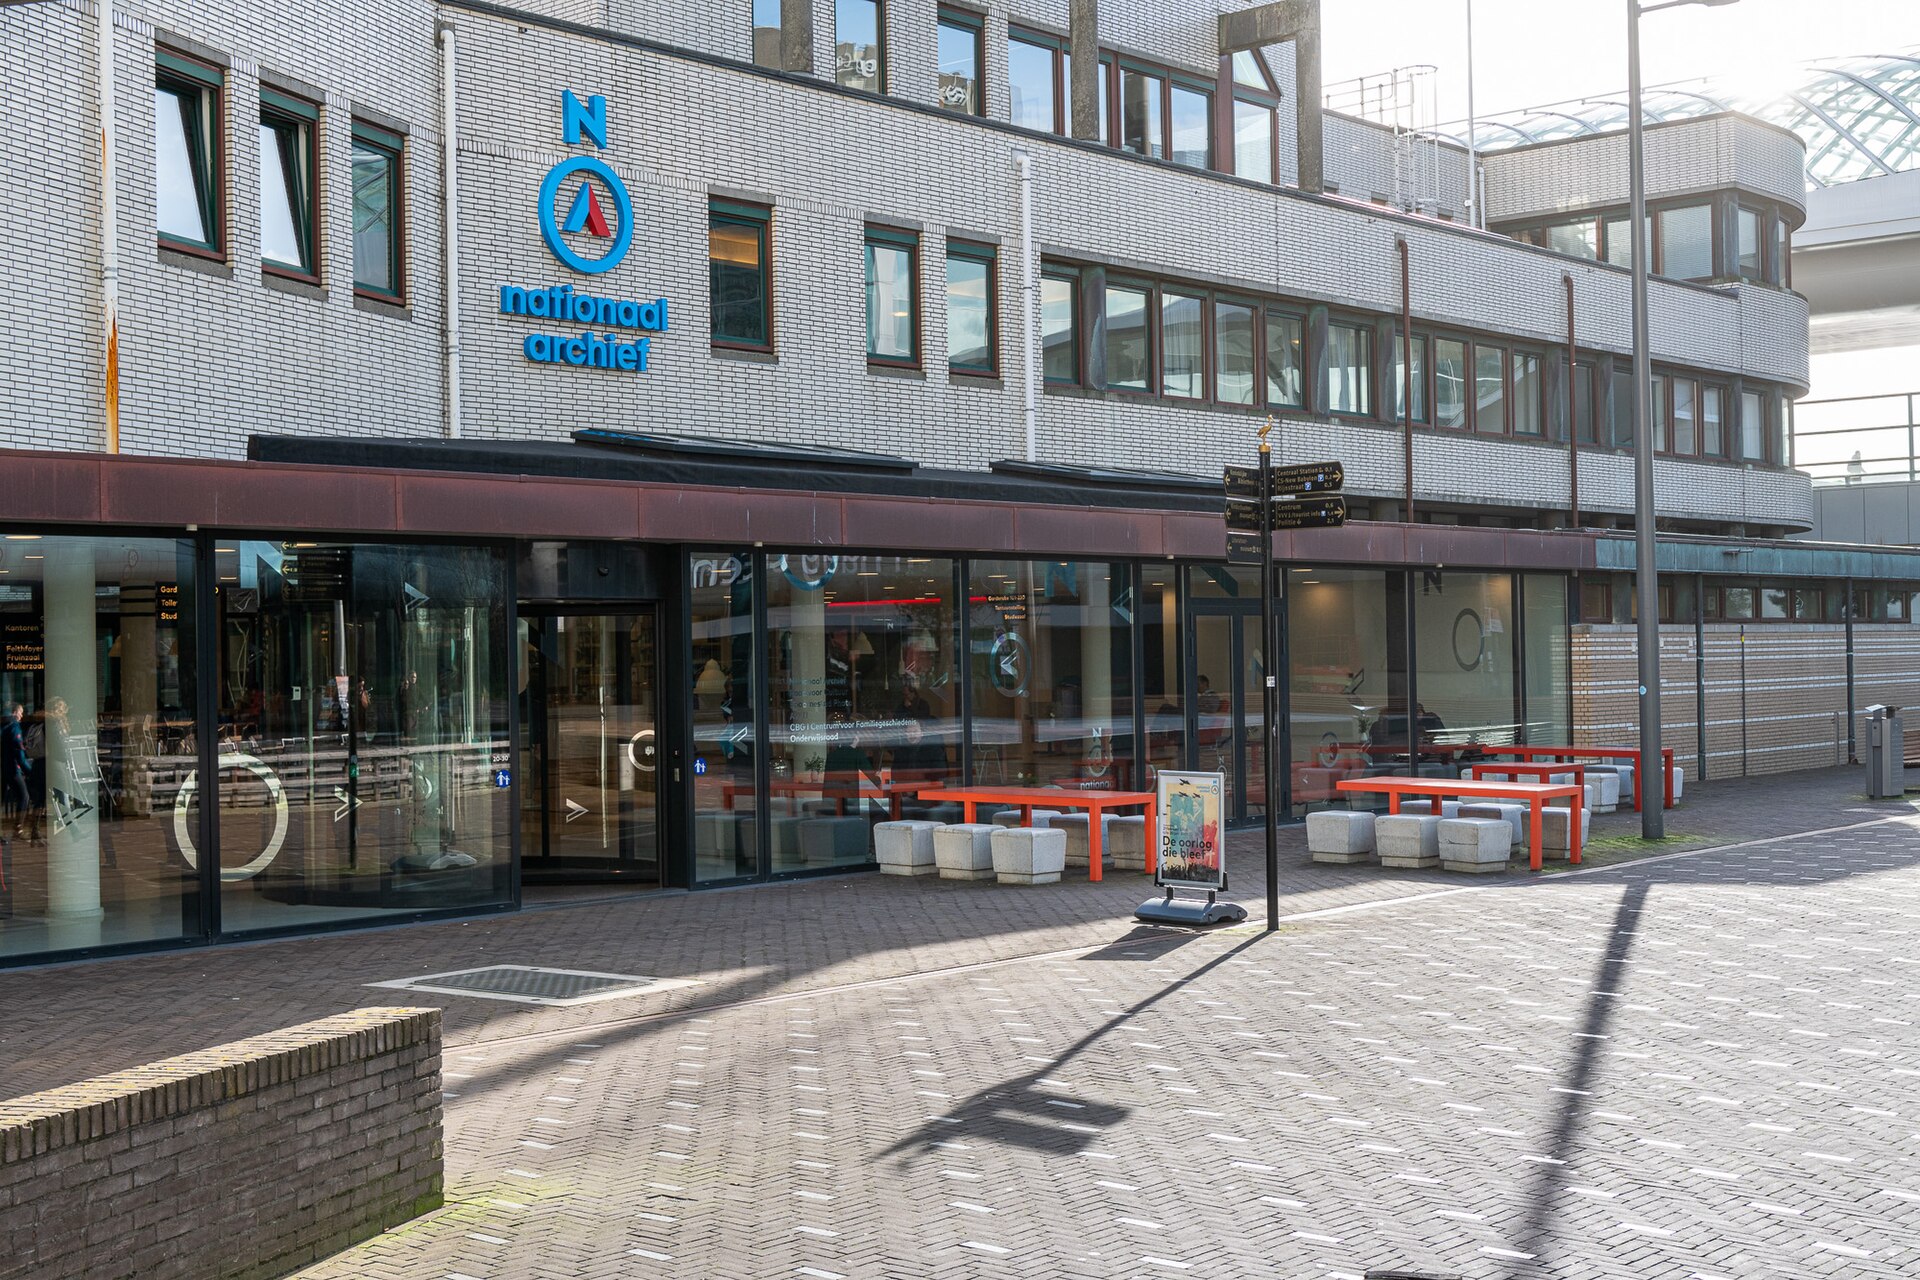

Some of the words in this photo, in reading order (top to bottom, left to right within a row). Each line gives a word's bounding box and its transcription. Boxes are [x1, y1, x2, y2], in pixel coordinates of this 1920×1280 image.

[562, 89, 607, 149] N
[500, 285, 668, 331] nationaal
[524, 332, 650, 371] archief
[1277, 469, 1298, 477] Centraal
[1299, 467, 1318, 475] Station
[161, 599, 178, 607] Toile
[5, 624, 39, 632] Kantoren
[6, 653, 40, 661] Fruinzaal
[790, 721, 806, 732] CBG
[810, 720, 840, 730] Centrum
[841, 720, 854, 730] voor
[855, 717, 917, 731] Familiegeschiedenis
[790, 732, 839, 743] Onderwijsraad
[1162, 835, 1176, 847] De
[1179, 837, 1212, 851] oorlog
[1162, 847, 1178, 858] die
[1180, 848, 1206, 860] bleef
